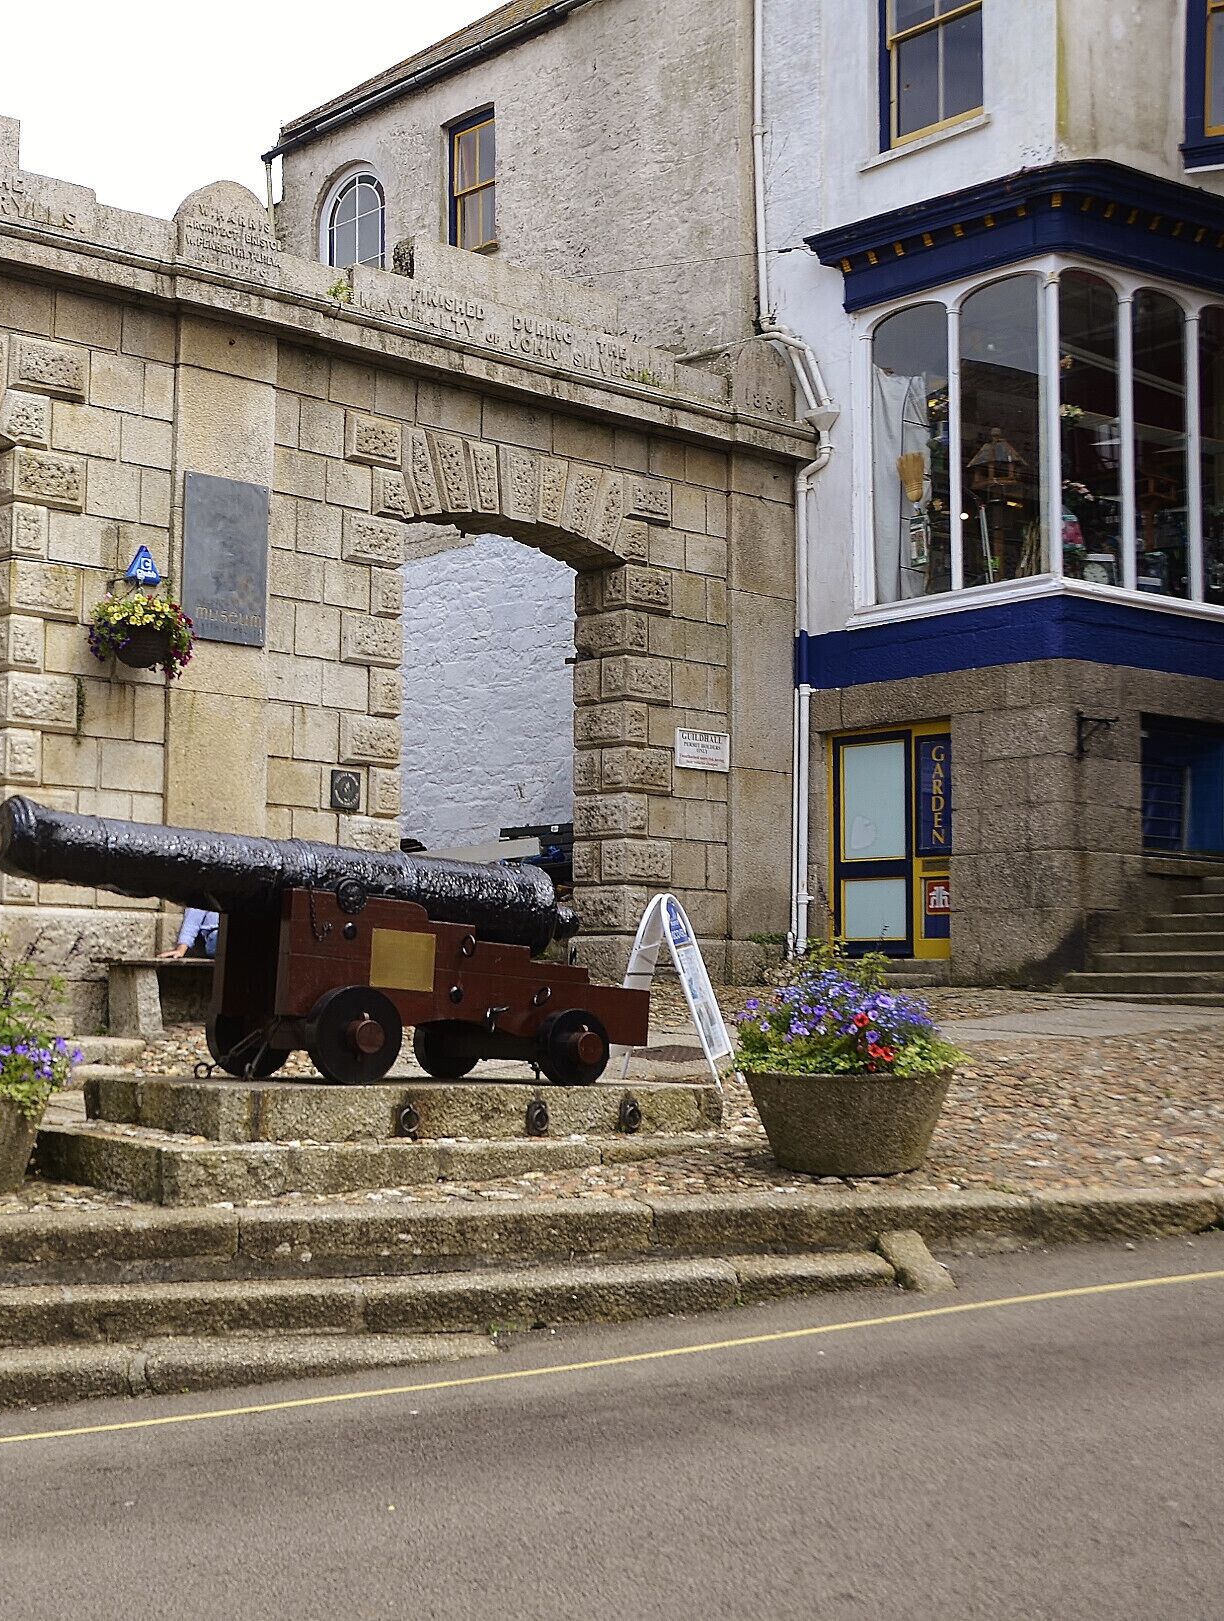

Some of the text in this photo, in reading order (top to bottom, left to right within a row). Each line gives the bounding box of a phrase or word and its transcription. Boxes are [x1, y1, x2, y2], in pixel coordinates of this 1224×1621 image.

[359, 291, 476, 338] MAYORALTY
[509, 334, 561, 361] JOHN
[411, 287, 627, 361] FINISHED DURING THE
[681, 732, 722, 744] GUILDHALL
[931, 745, 946, 845] GARDEN
